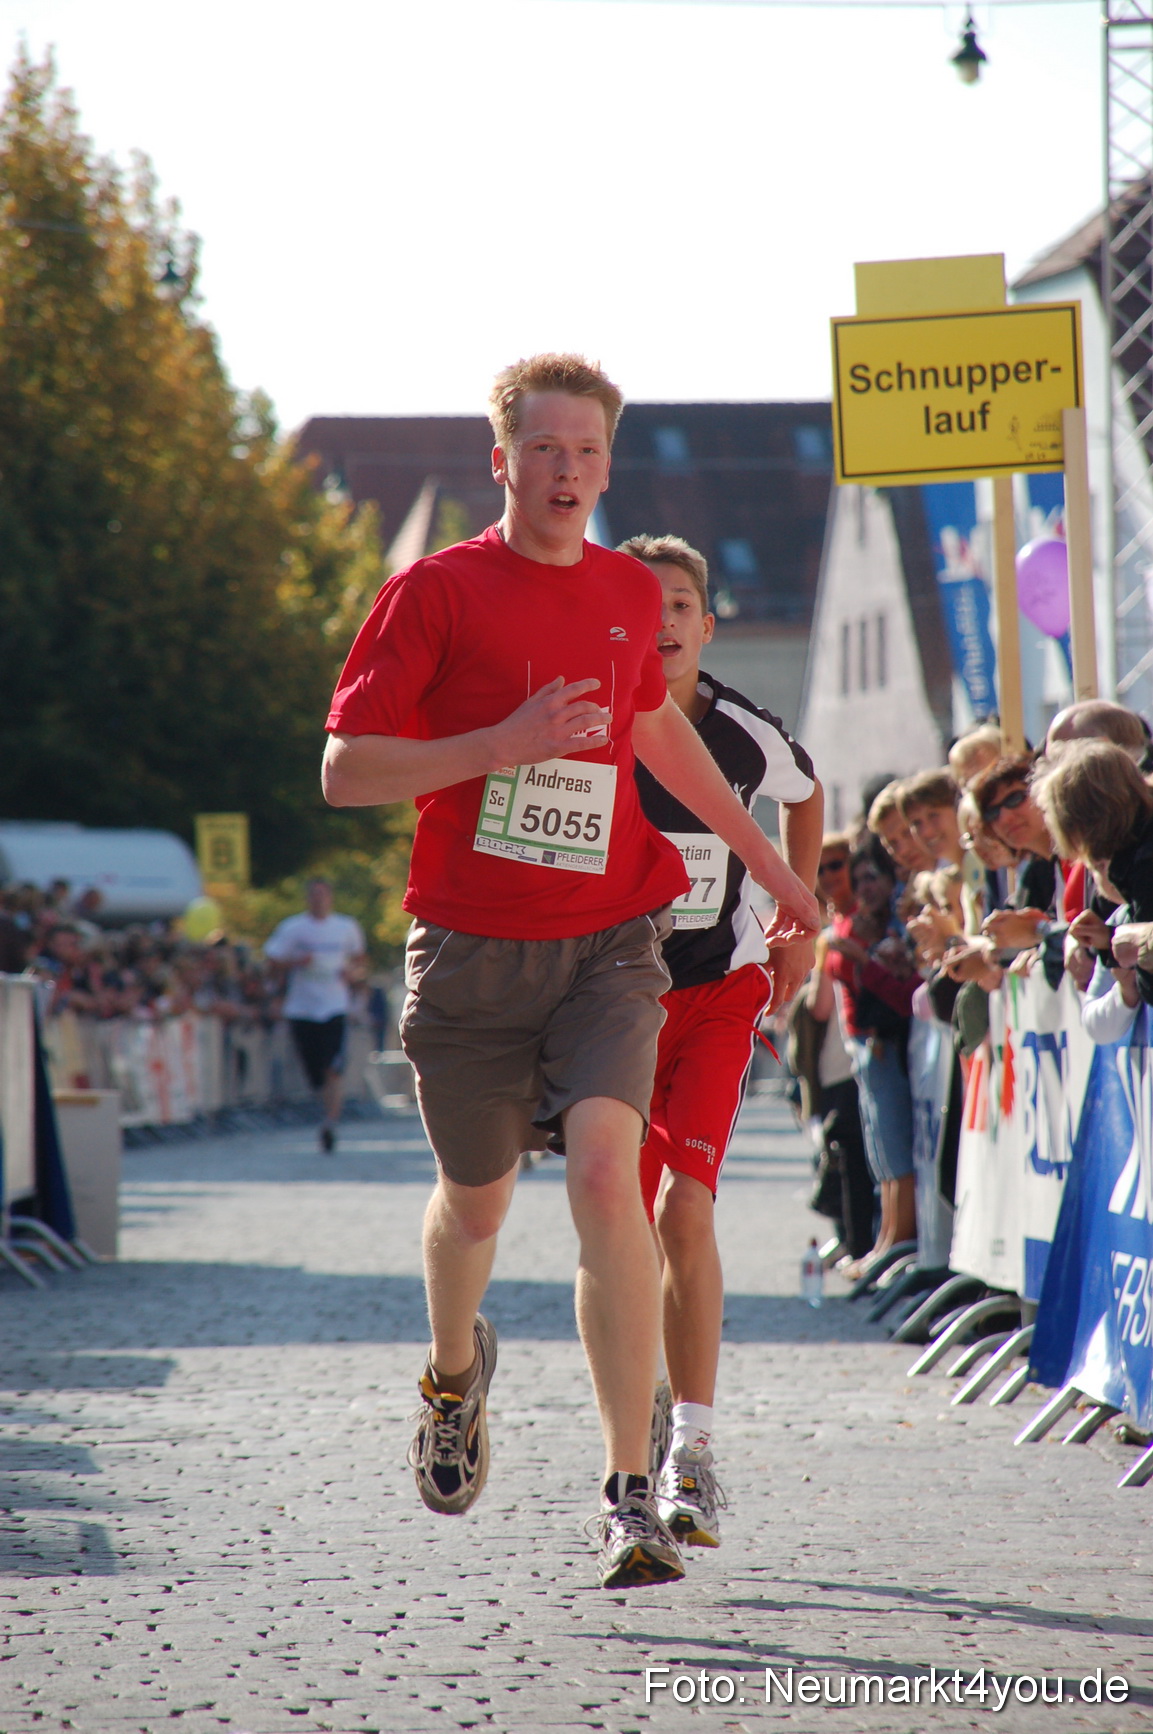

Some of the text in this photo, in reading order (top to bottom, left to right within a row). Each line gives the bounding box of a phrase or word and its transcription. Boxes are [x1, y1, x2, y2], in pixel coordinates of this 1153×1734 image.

[849, 358, 1062, 395] Schnupper-
[923, 401, 990, 435] lauf
[524, 765, 592, 794] Andreas
[488, 790, 505, 806] Sc
[520, 804, 602, 842] 5055
[477, 837, 526, 855] BOCK
[557, 852, 604, 867] PFLEIDERER
[685, 1138, 716, 1157] SOCCER
